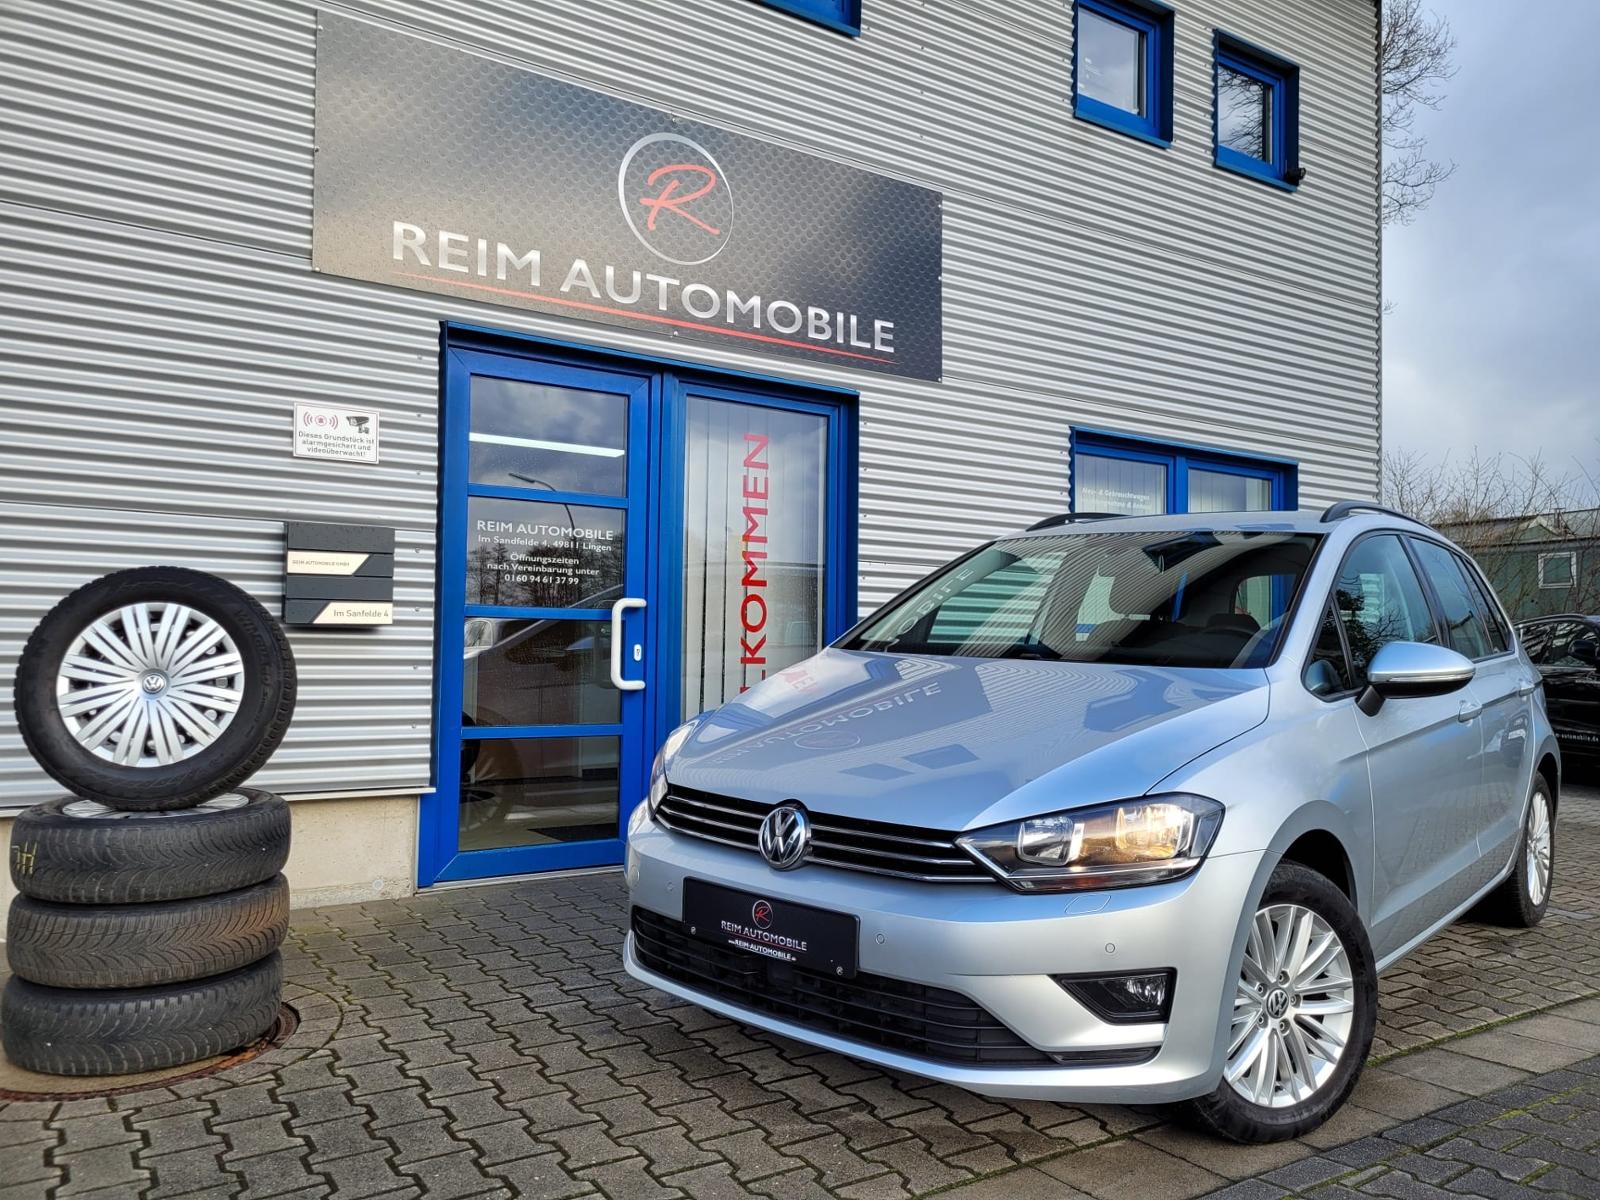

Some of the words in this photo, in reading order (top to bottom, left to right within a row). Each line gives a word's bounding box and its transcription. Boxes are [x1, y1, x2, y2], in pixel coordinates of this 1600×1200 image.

[640, 164, 721, 236] R
[393, 220, 541, 287] REIM
[559, 258, 895, 353] AUTOMOBILE
[298, 431, 322, 439] Dieses
[324, 433, 363, 444] Grundstück
[302, 438, 356, 450] alarmgesichert
[357, 443, 371, 451] und
[307, 445, 366, 457] videoüberwacht!
[477, 520, 513, 533] REIM
[516, 523, 614, 540] AUTOMOBILE
[478, 534, 491, 543] Im
[493, 535, 539, 546] Sandfelde
[552, 540, 579, 549] 49811
[583, 542, 612, 553] Lingen
[510, 551, 579, 565] Öffnungszeiten
[487, 562, 509, 571] nach
[510, 563, 573, 576] Vereinbarung
[575, 567, 600, 576] unter
[504, 573, 528, 582] 0160
[529, 575, 541, 583] 94
[555, 576, 566, 584] 37
[568, 577, 579, 585] 99
[333, 608, 344, 617] Im
[721, 920, 742, 934] REIM
[743, 927, 808, 952] AUTOMOBILE
[728, 939, 797, 961] REIM-AUTOMOBILE
